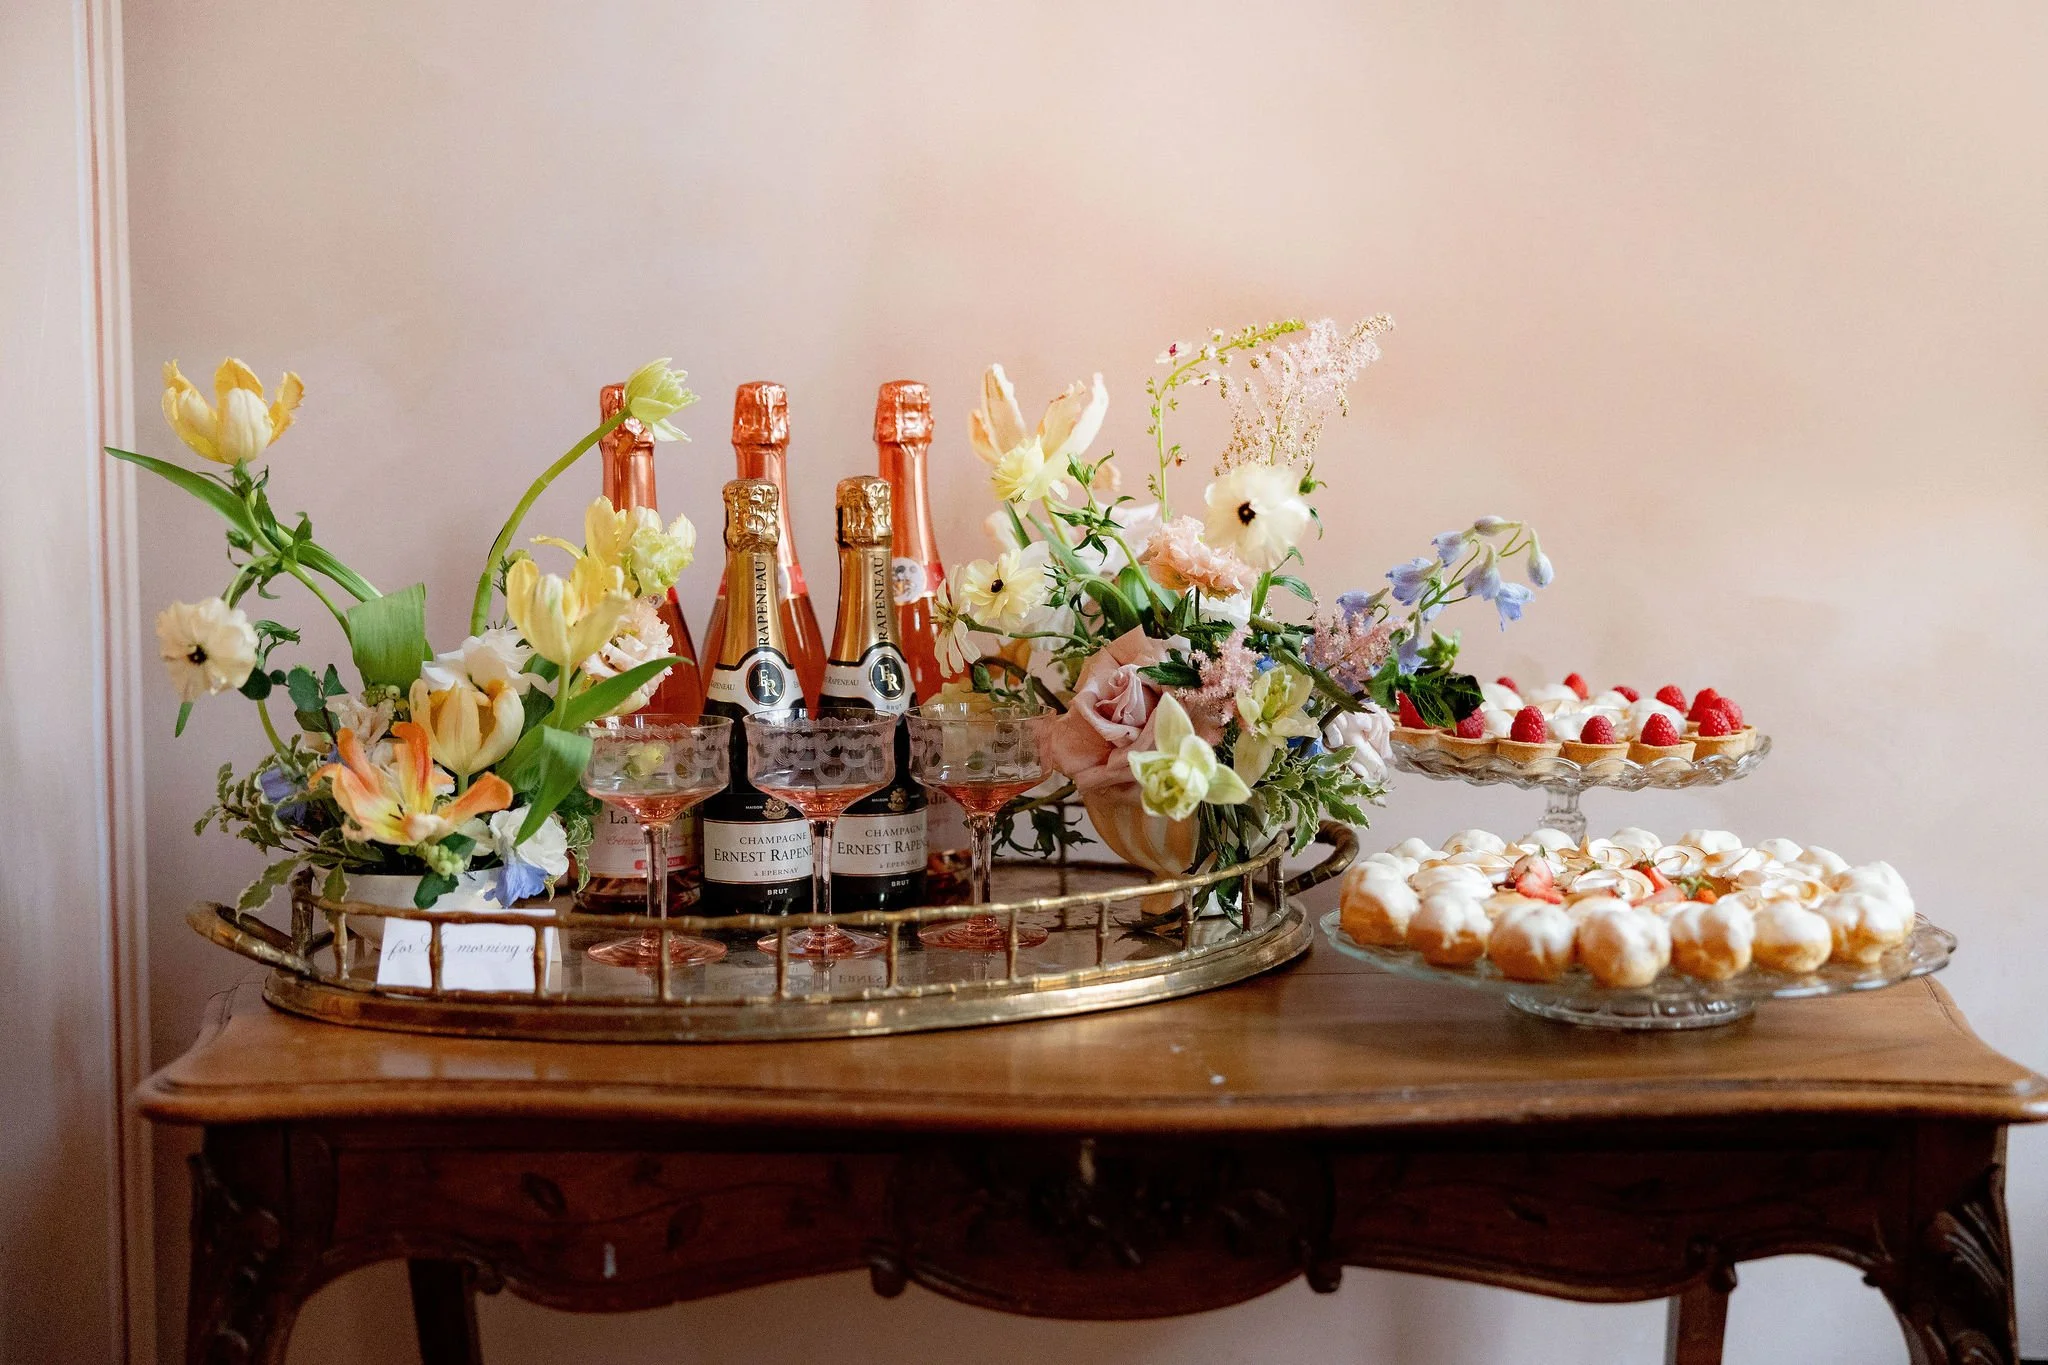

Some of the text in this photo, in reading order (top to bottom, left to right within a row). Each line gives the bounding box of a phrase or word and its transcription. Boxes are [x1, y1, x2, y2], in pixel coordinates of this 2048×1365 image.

[755, 560, 770, 646] RAPENEAU
[874, 557, 889, 642] RAPENEAU
[609, 810, 629, 825] La
[739, 831, 807, 845] CHAMPAGNE
[865, 823, 923, 838] CHAMPAGN
[713, 844, 813, 863] ERNEST RAPENE
[837, 838, 926, 855] ERNEST RAPEN
[891, 879, 910, 887] BRUT
[767, 887, 789, 896] BRUT
[387, 939, 417, 961] for
[456, 941, 521, 962] morning
